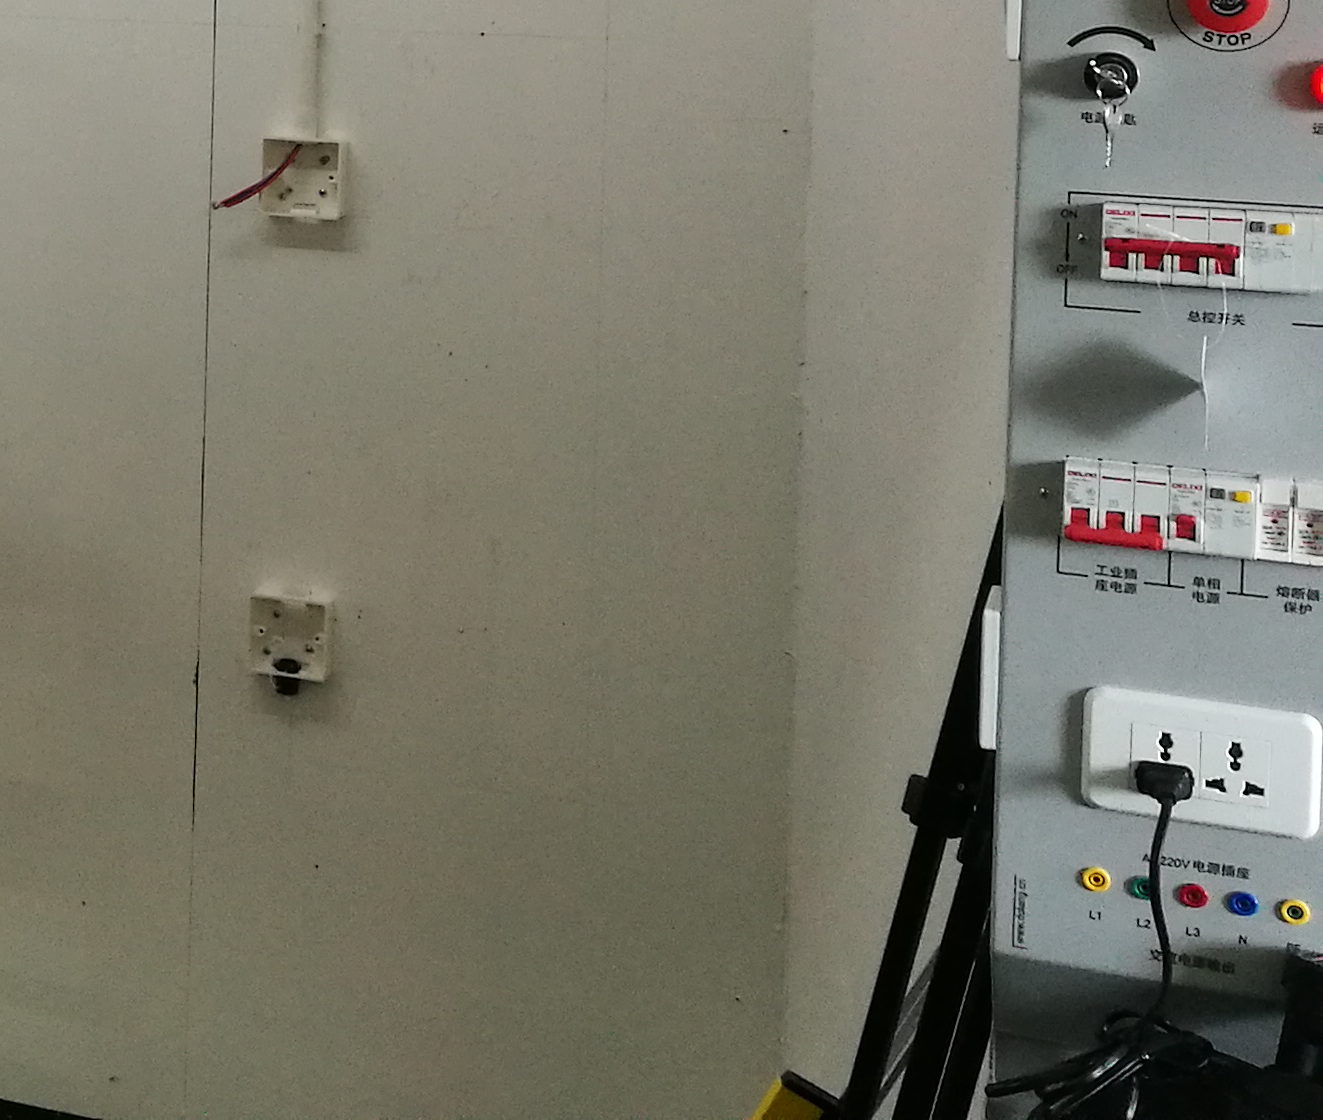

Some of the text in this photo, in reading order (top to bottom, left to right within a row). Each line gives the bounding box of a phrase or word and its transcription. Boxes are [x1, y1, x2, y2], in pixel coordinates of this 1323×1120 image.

[1202, 31, 1252, 46] STOP
[1061, 208, 1077, 219] ON
[1187, 310, 1246, 326] 总控开关
[1192, 591, 1220, 604] 电源
[1283, 601, 1313, 615] 保护
[1089, 911, 1102, 921] L1
[1137, 918, 1151, 929] L2
[1185, 926, 1200, 937] L3
[1238, 935, 1248, 945] N
